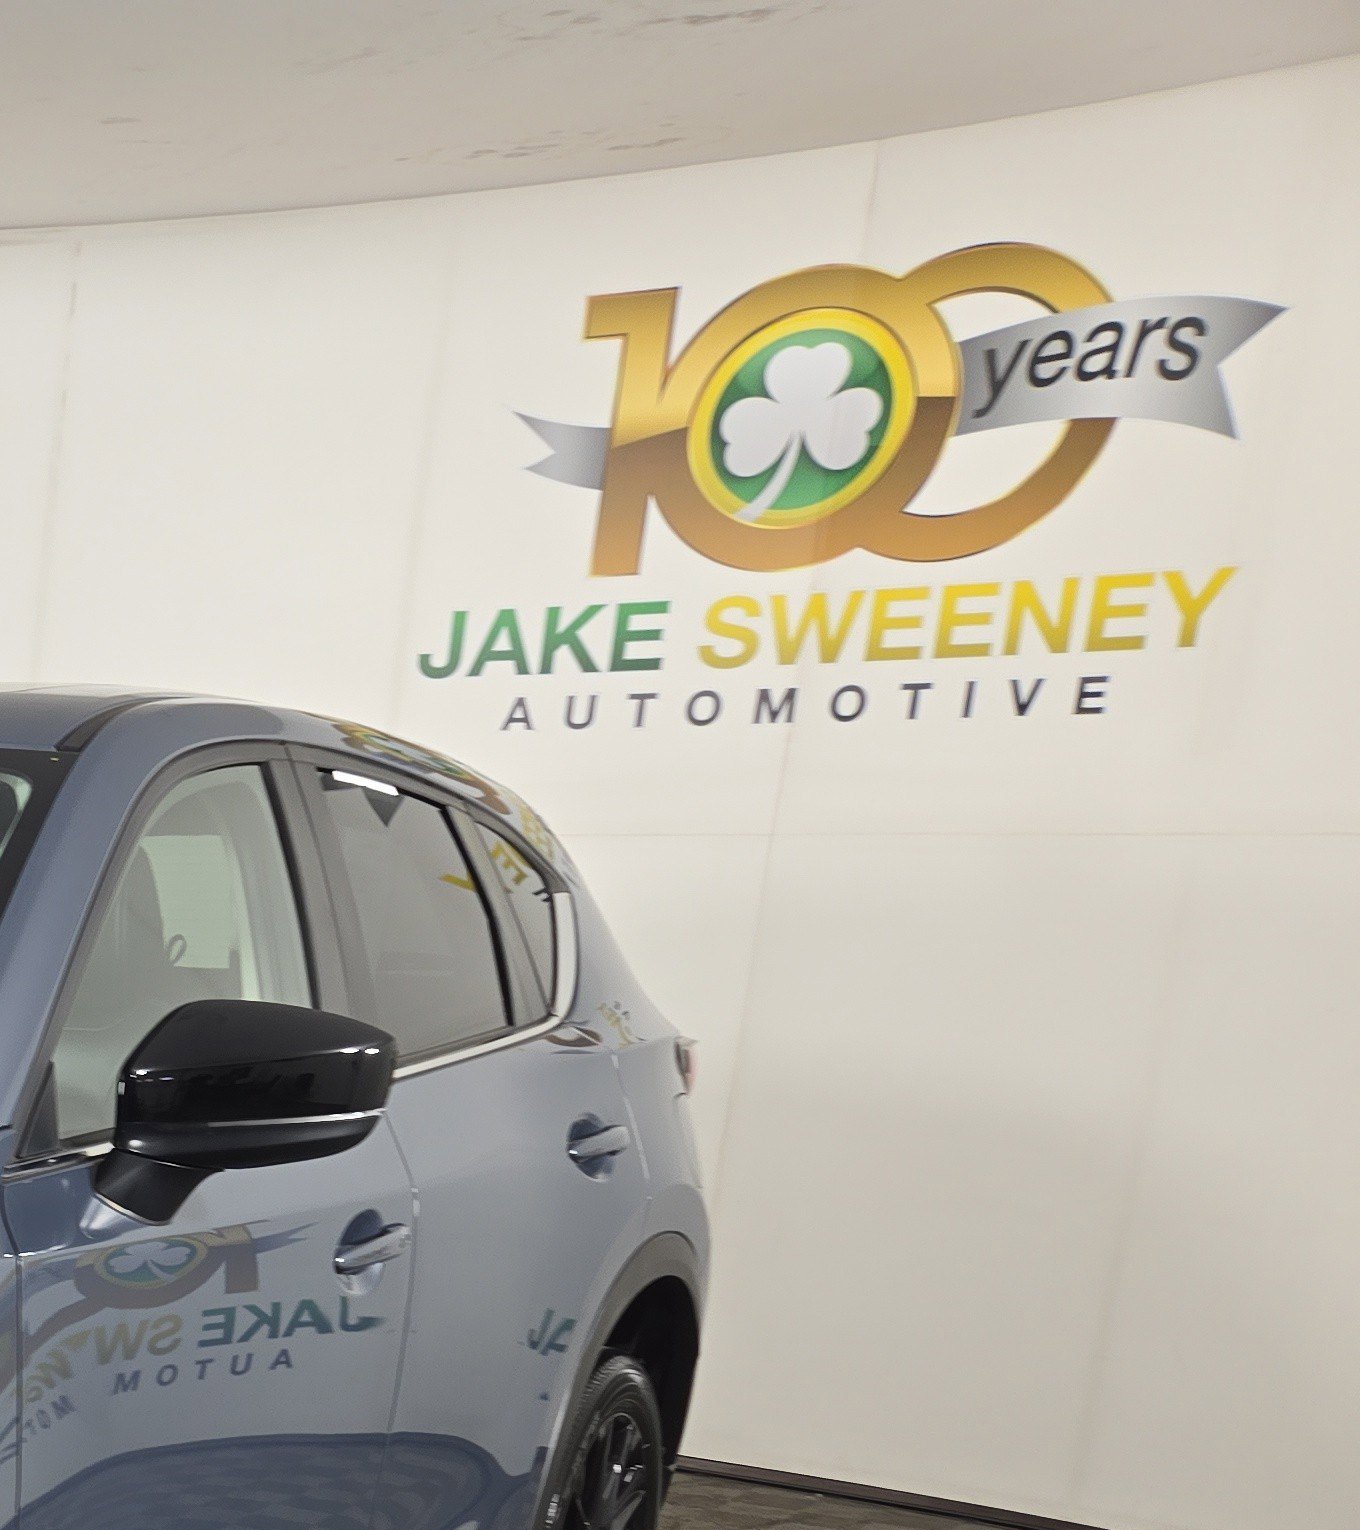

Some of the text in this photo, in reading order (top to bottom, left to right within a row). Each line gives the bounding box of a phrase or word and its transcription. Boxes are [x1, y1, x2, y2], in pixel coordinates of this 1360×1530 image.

[582, 241, 1208, 577] 100 years
[418, 567, 1239, 679] JAKE SWEENEY
[502, 675, 1111, 732] AUTOMOTIVE
